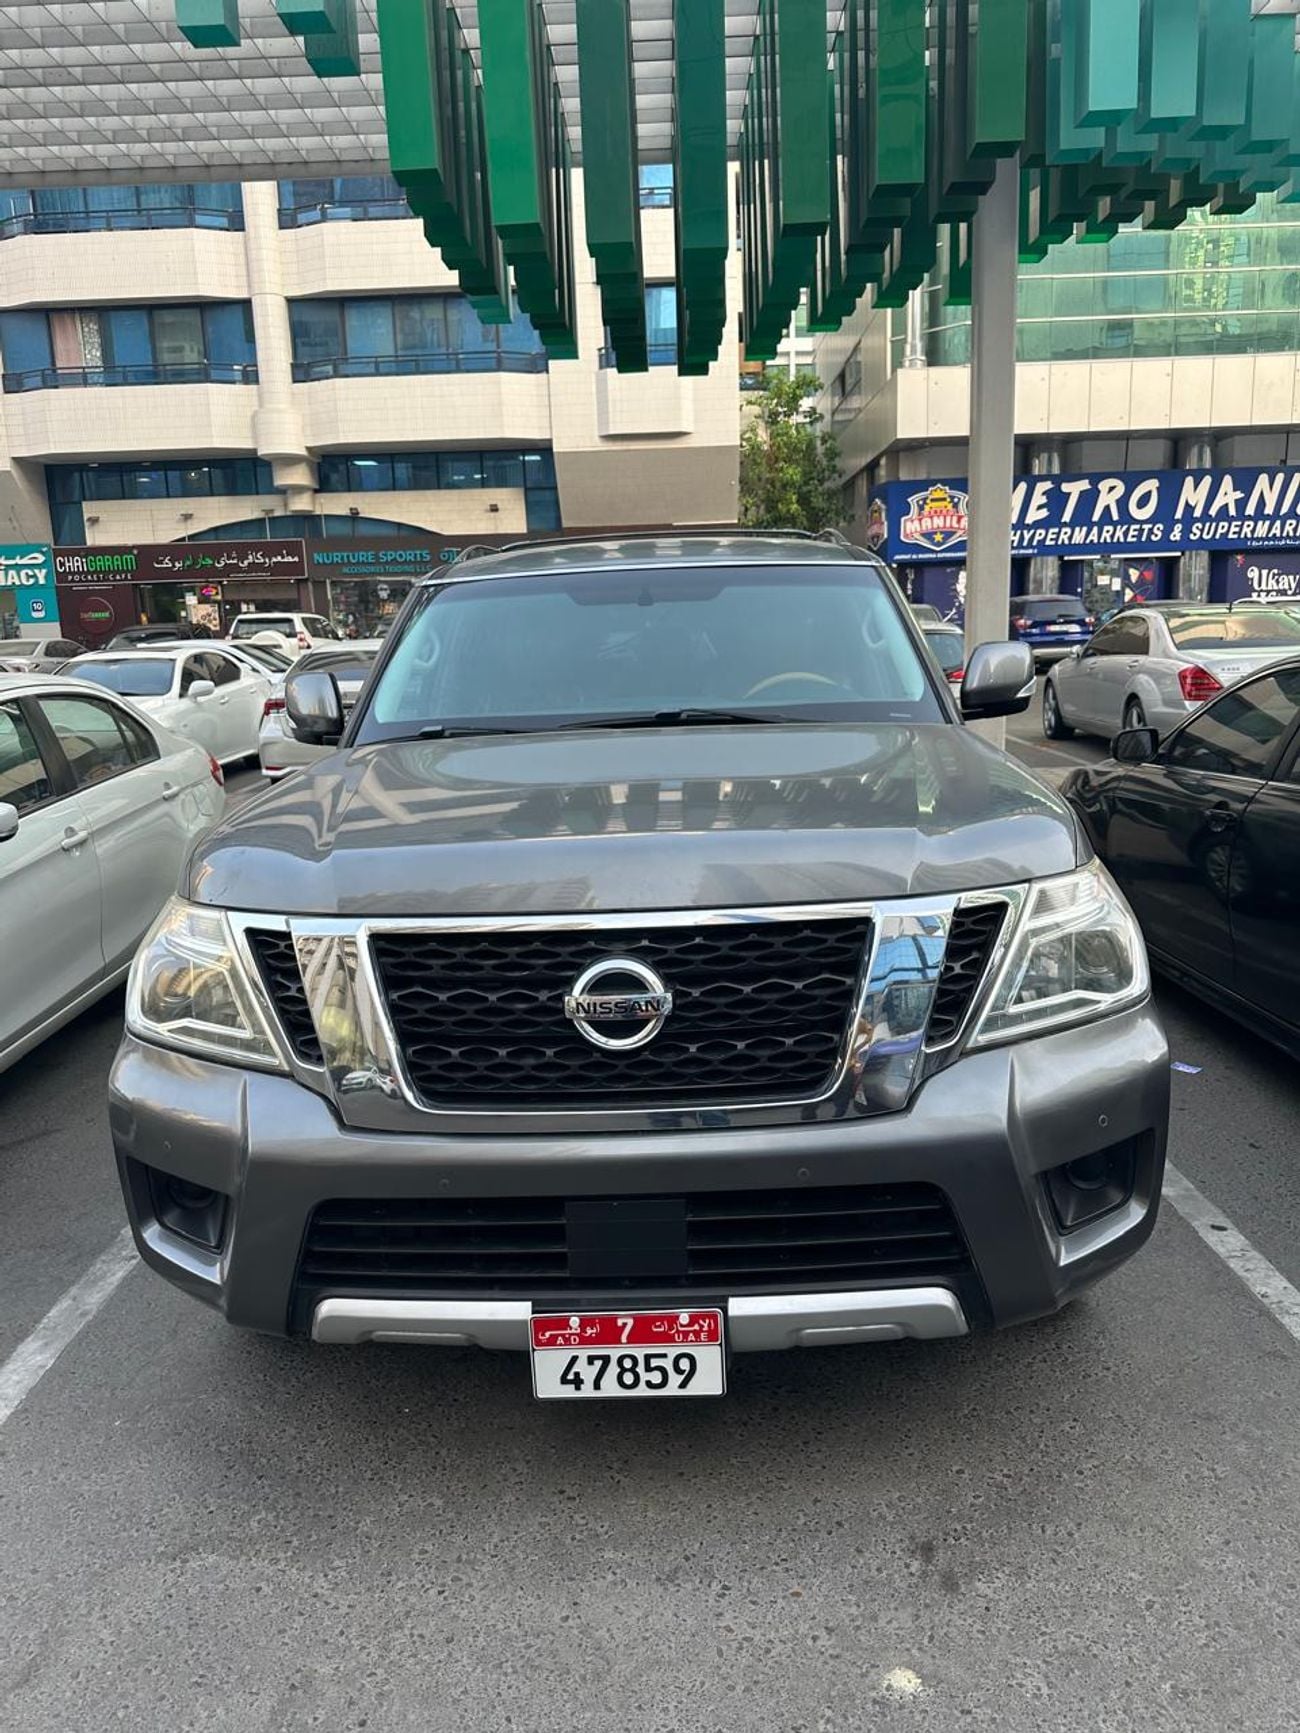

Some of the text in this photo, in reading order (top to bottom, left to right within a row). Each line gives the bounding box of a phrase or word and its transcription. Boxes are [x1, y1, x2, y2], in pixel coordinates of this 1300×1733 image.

[1174, 472, 1300, 520] MANI
[1011, 519, 1300, 547] HYPERMARKETS & SUPERMAR
[313, 551, 376, 564] NURTURE
[379, 550, 431, 563] SPORTS
[32, 602, 43, 611] 10
[575, 999, 661, 1015] NISSAN
[616, 1317, 634, 1343] 7
[560, 1352, 698, 1391] 47859
